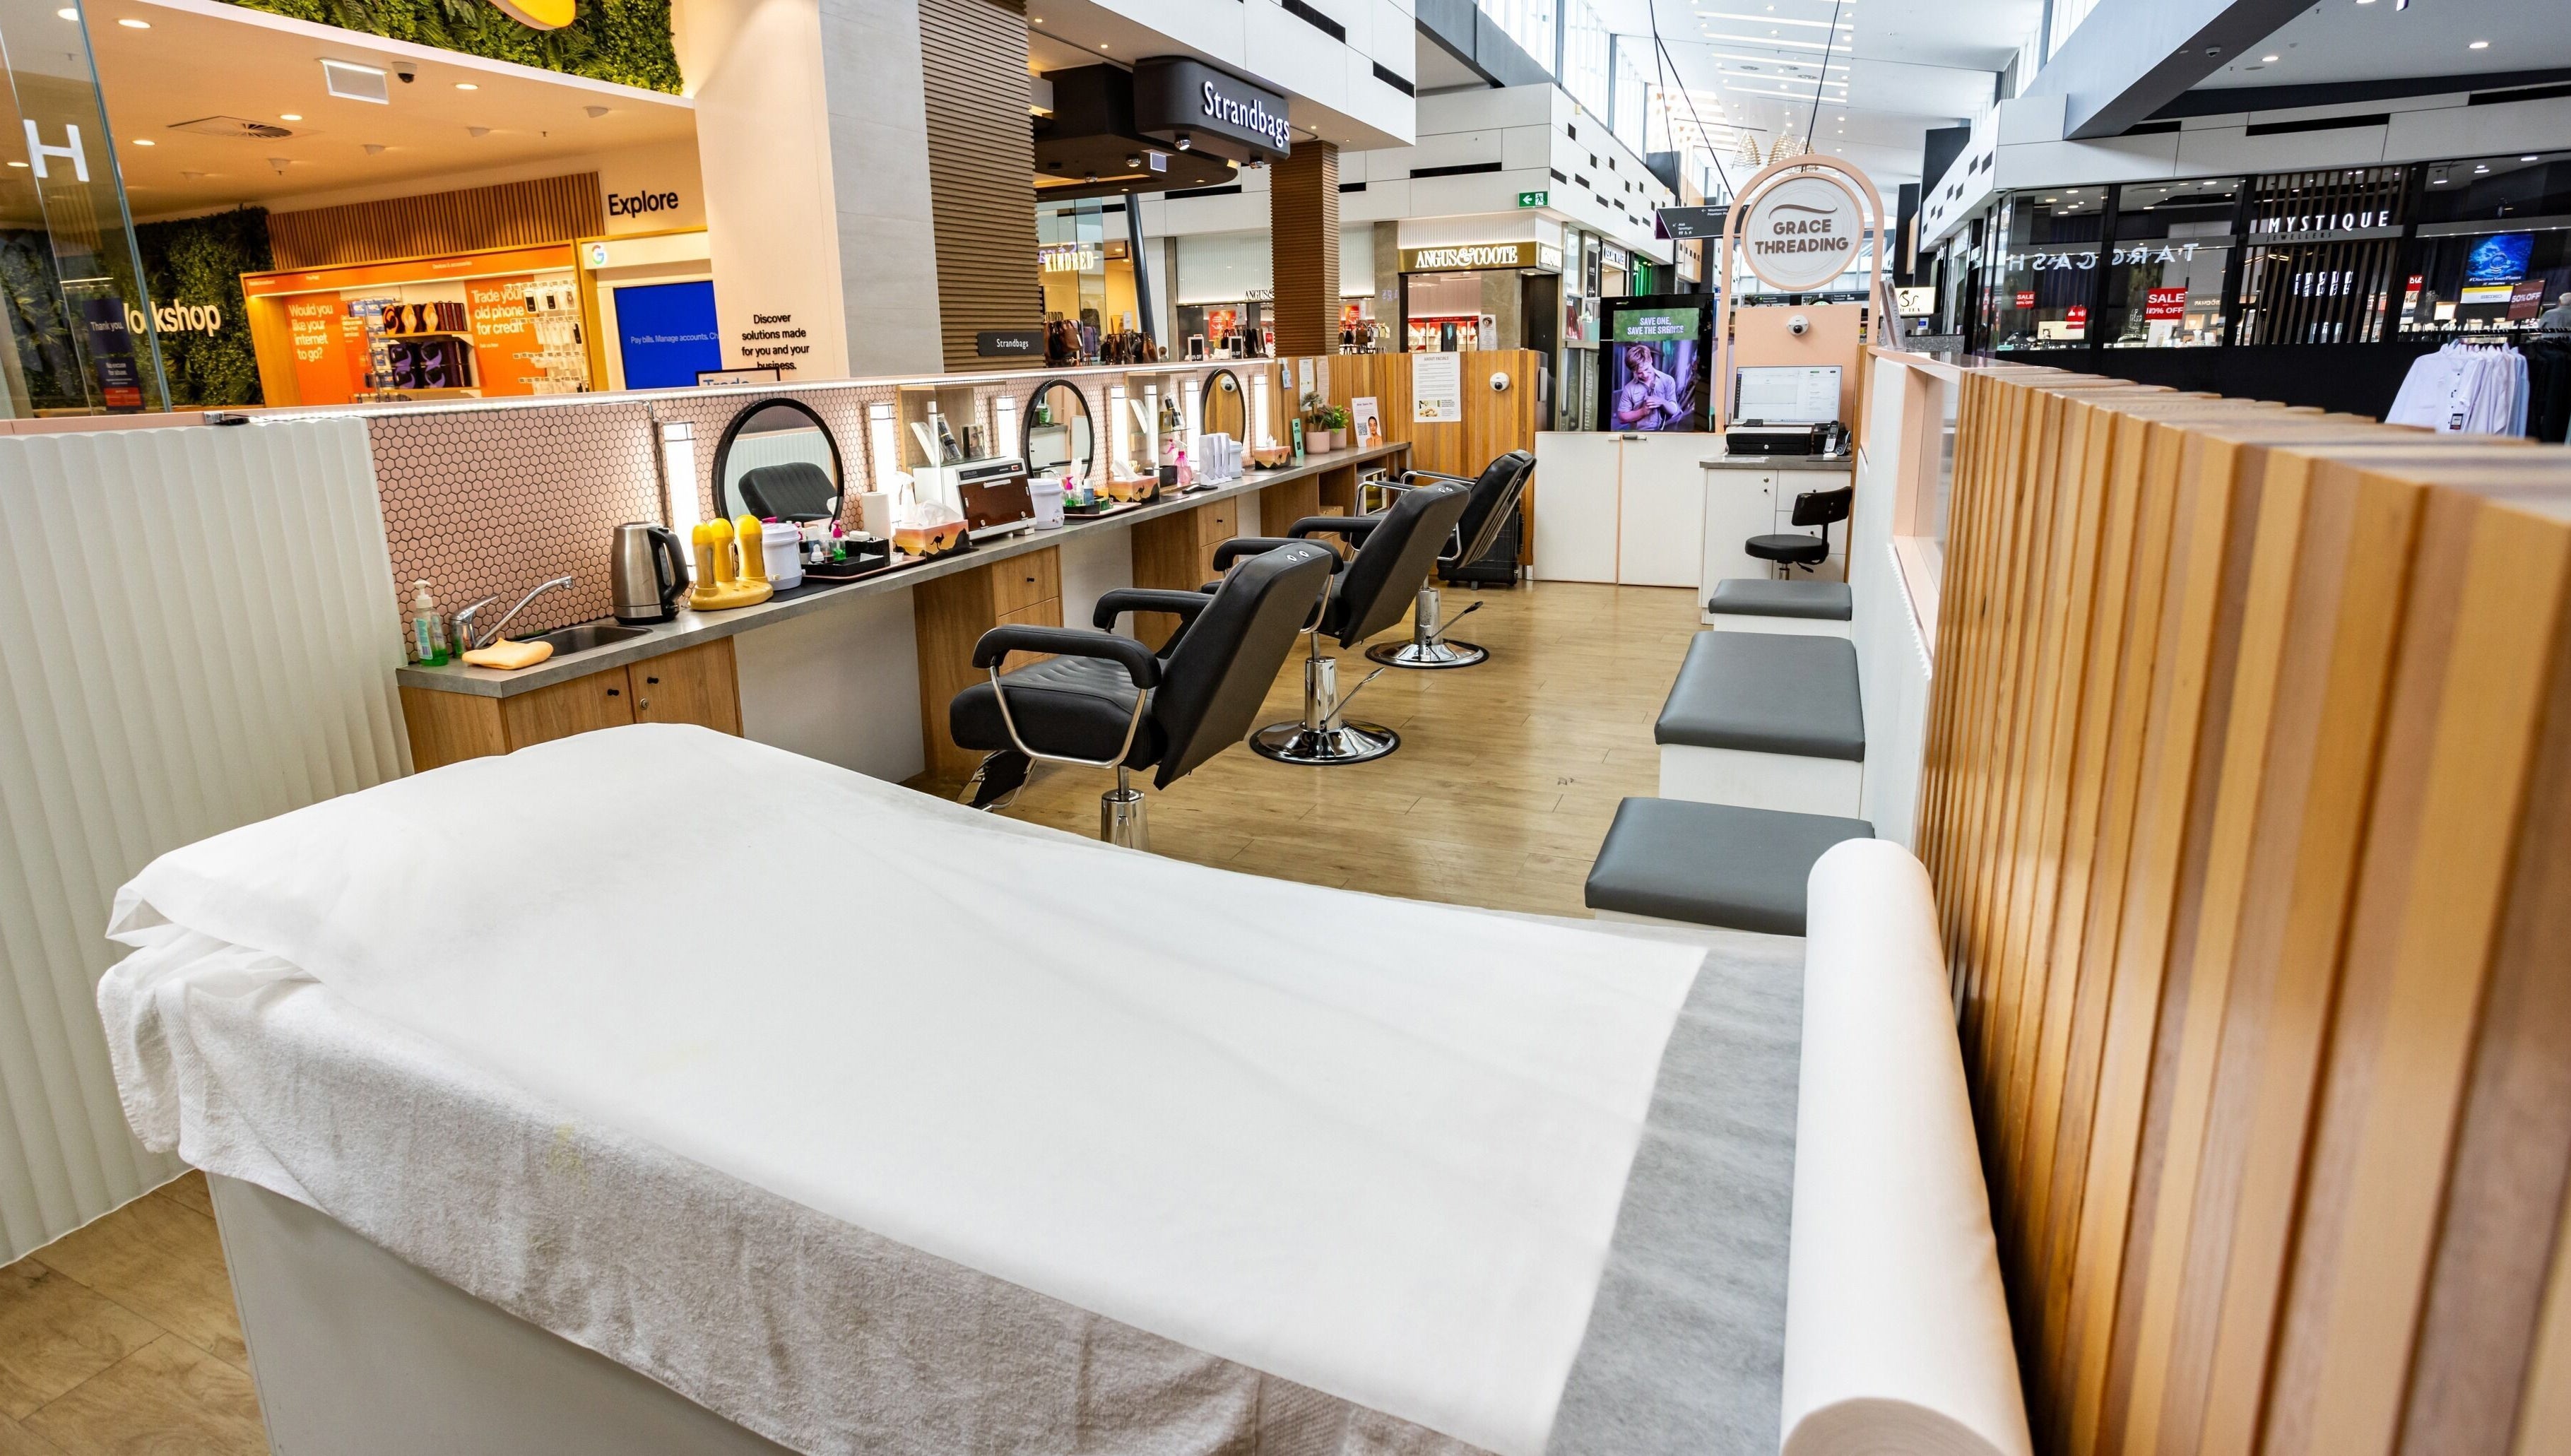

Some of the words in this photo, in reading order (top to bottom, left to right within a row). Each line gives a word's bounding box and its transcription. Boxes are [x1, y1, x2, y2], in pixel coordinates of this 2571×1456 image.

[1205, 81, 1289, 148] Strandbags
[24, 119, 90, 182] H
[608, 190, 679, 218] Explore
[1773, 219, 1831, 235] GRACE
[2268, 211, 2389, 233] MYSTIQUE
[2266, 232, 2332, 242] JEWELLERS
[1755, 237, 1848, 254] THREADING
[1046, 251, 1094, 273] KINDRED
[1415, 246, 1518, 268] ANGUS&COOTE
[471, 289, 500, 304] Trade
[500, 289, 524, 304] your
[2148, 293, 2185, 304] SALE
[2511, 293, 2526, 303] 50%
[2526, 292, 2541, 300] OFF
[288, 304, 317, 317] Would
[317, 304, 333, 317] you
[474, 305, 490, 319] old
[491, 304, 524, 321] phone
[1046, 312, 1063, 321] INDRED
[123, 299, 221, 337] okshop
[753, 313, 791, 324] Discover
[1640, 317, 1655, 326] SAVE
[1657, 316, 1672, 326] ONE,
[90, 321, 110, 331] Thank
[110, 321, 124, 332] you.
[291, 319, 307, 332] like
[307, 320, 326, 333] your
[477, 321, 491, 335] for
[1627, 326, 1643, 335] SAVE
[1644, 326, 1656, 334] THE
[294, 333, 329, 346] internet
[631, 336, 642, 345] Pay
[656, 335, 679, 343] Manage
[680, 333, 708, 341] accounts.
[742, 329, 781, 341] solutions
[781, 329, 807, 339] made
[996, 338, 1029, 350] Strandbags
[297, 348, 307, 360] to
[307, 347, 324, 362] go?
[742, 346, 754, 357] for
[755, 348, 771, 357] you
[772, 345, 788, 355] and
[790, 345, 810, 357] your
